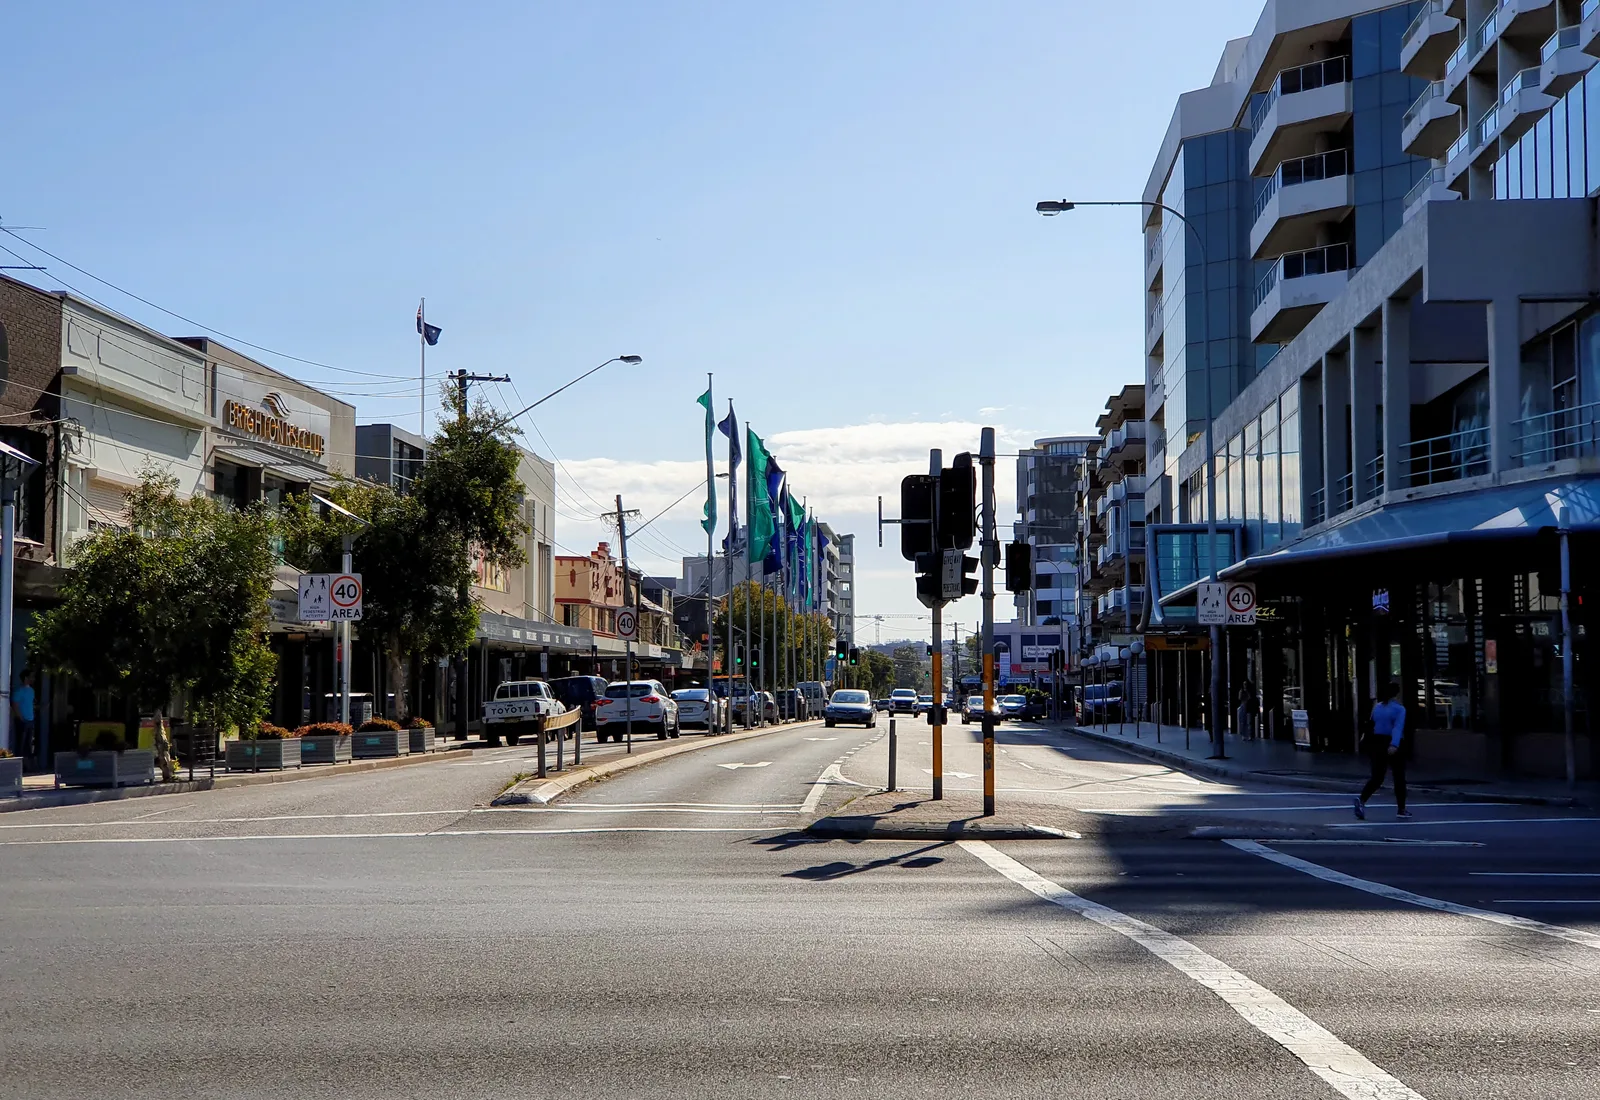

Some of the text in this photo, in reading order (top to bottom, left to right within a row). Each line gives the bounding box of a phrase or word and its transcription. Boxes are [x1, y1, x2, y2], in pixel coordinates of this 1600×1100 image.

[226, 400, 284, 444] BRIGHTON
[303, 430, 325, 457] CLUB
[335, 584, 357, 599] 40
[1231, 592, 1251, 605] 40
[331, 608, 361, 618] AREA
[1227, 614, 1255, 623] AREA
[619, 617, 633, 629] 40
[491, 706, 530, 715] TOYOTA
